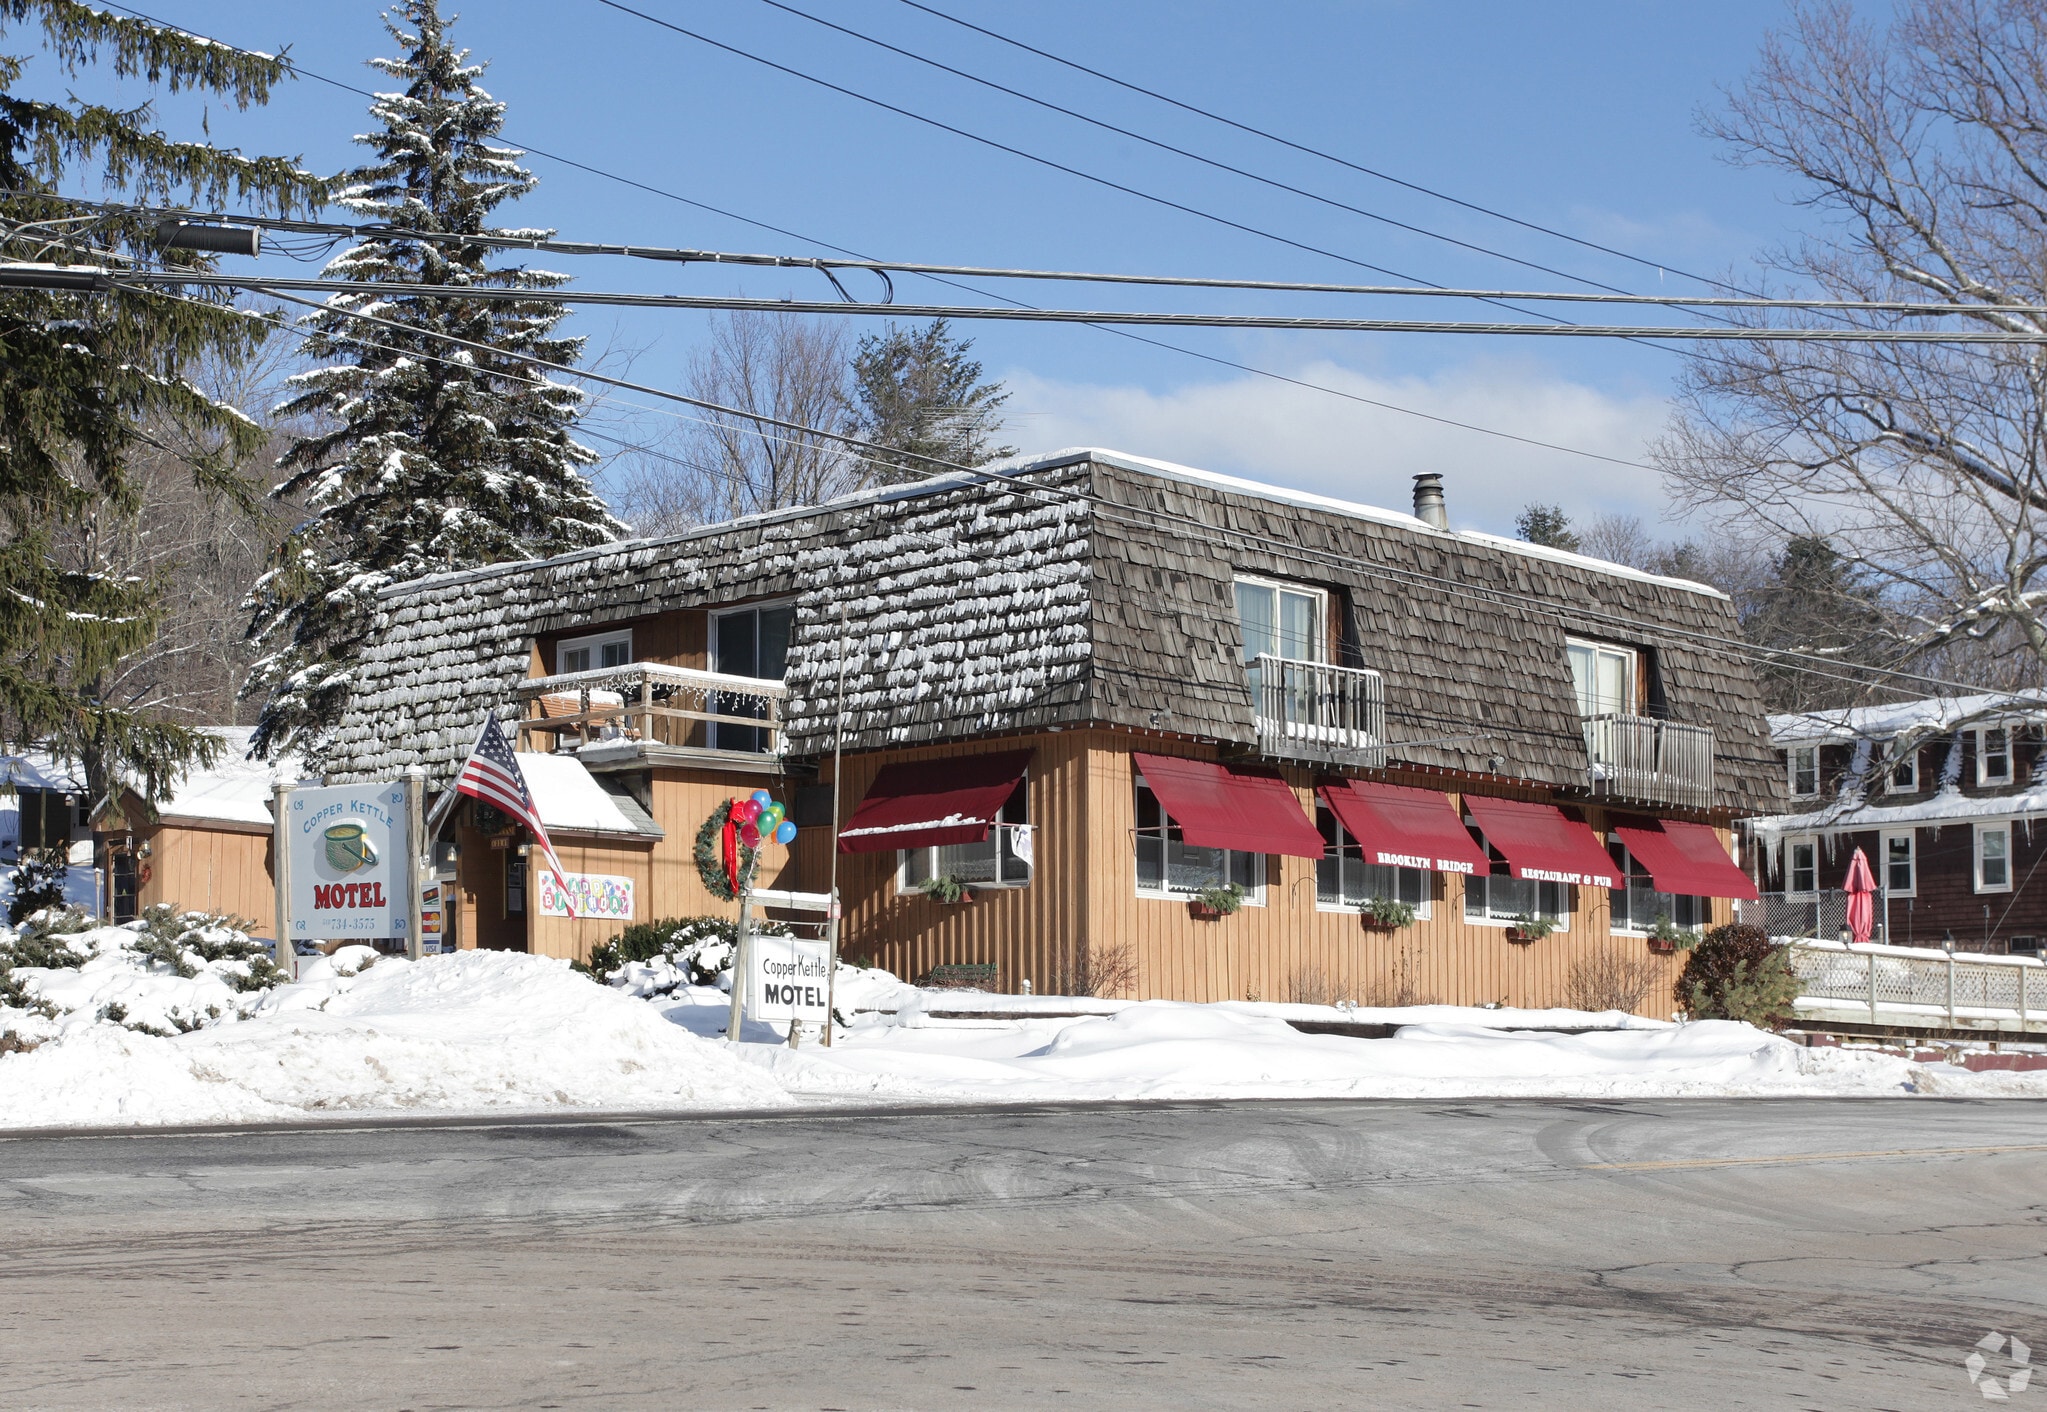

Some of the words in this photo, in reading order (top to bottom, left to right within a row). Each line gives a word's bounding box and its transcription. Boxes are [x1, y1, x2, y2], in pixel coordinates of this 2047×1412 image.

[303, 803, 343, 834] COPPER
[350, 800, 394, 829] KETTLE
[1377, 852, 1431, 869] BROOKLYN
[1436, 859, 1474, 874] BRIDGE
[558, 878, 614, 898] APPY
[1521, 867, 1582, 885] RESTAURANT
[1583, 874, 1591, 885] &
[1593, 877, 1612, 888] PUB
[314, 882, 387, 910] MOTEL
[425, 945, 437, 953] VISA
[763, 958, 797, 980] Copper
[797, 955, 826, 978] Kettle
[765, 984, 826, 1007] MOTEL
